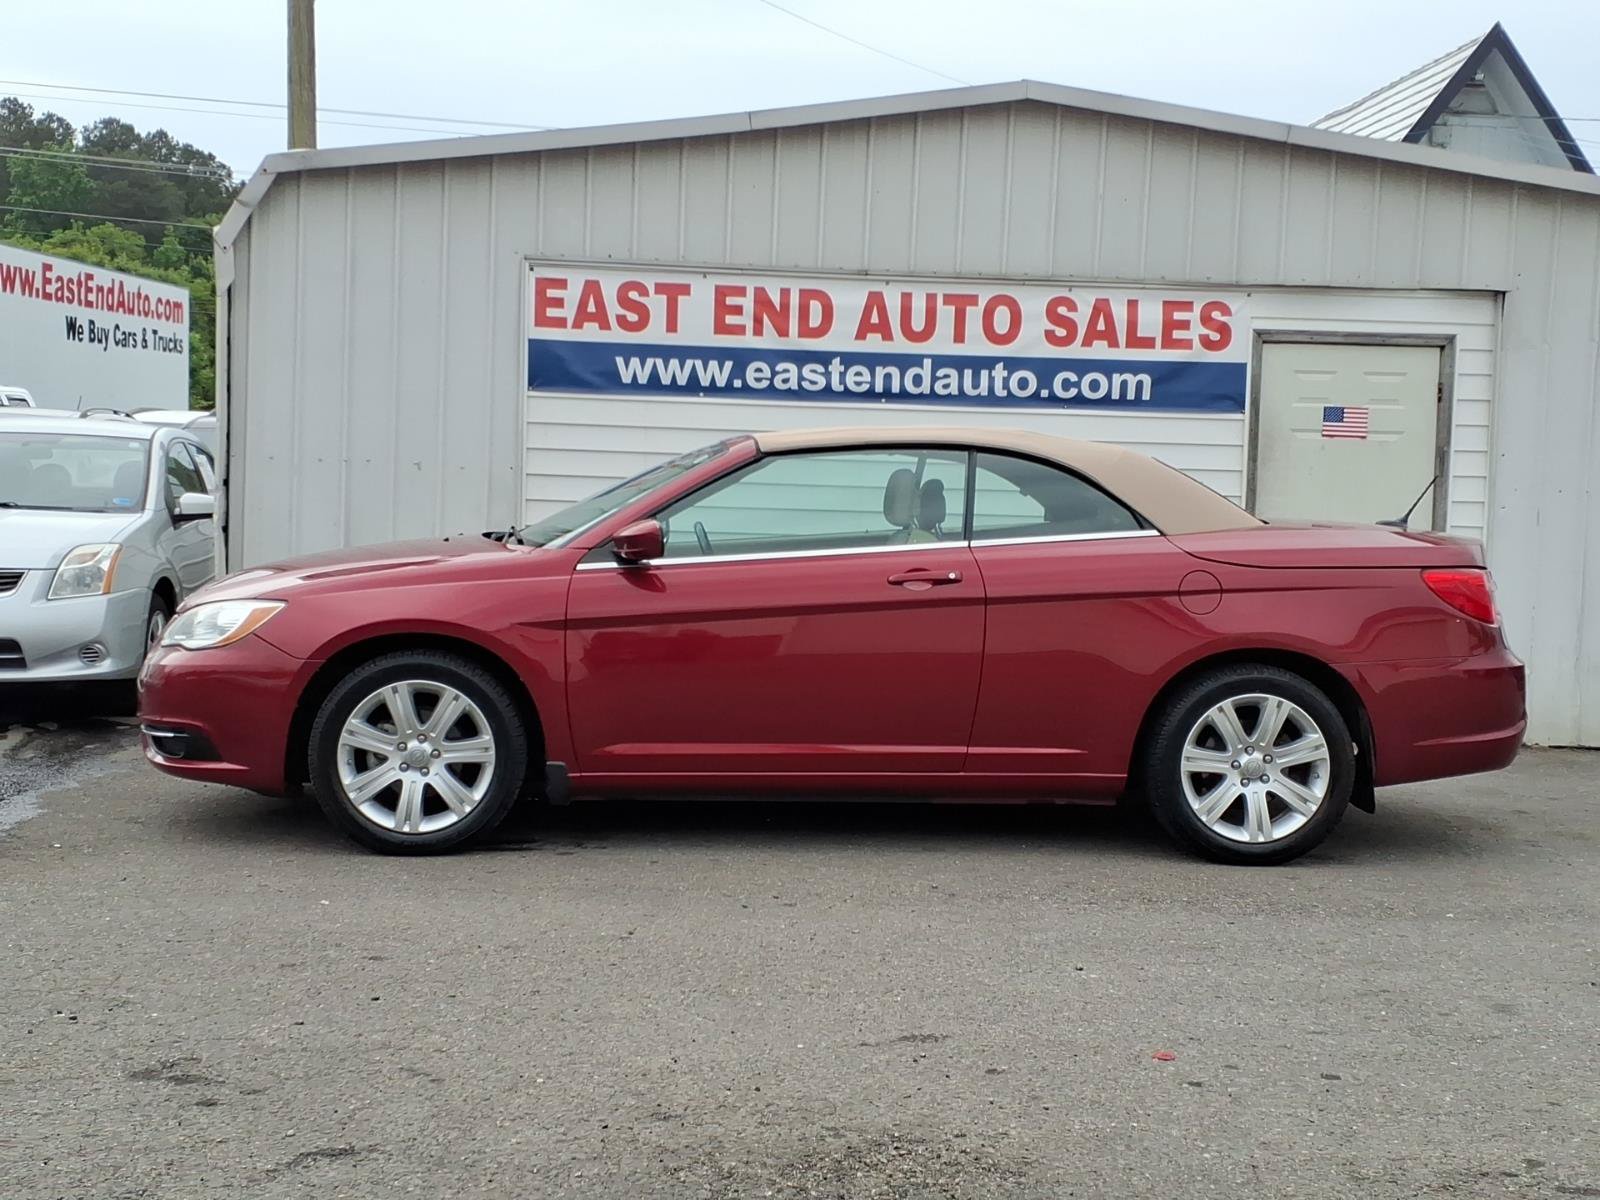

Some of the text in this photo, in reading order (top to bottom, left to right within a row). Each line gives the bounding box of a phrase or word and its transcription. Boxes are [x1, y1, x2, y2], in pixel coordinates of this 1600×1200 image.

[65, 315, 183, 354] We Buy Cars & Trucks
[534, 276, 1233, 352] EAST END AUTO SALES
[615, 356, 1152, 401] www.eastendauto.com
